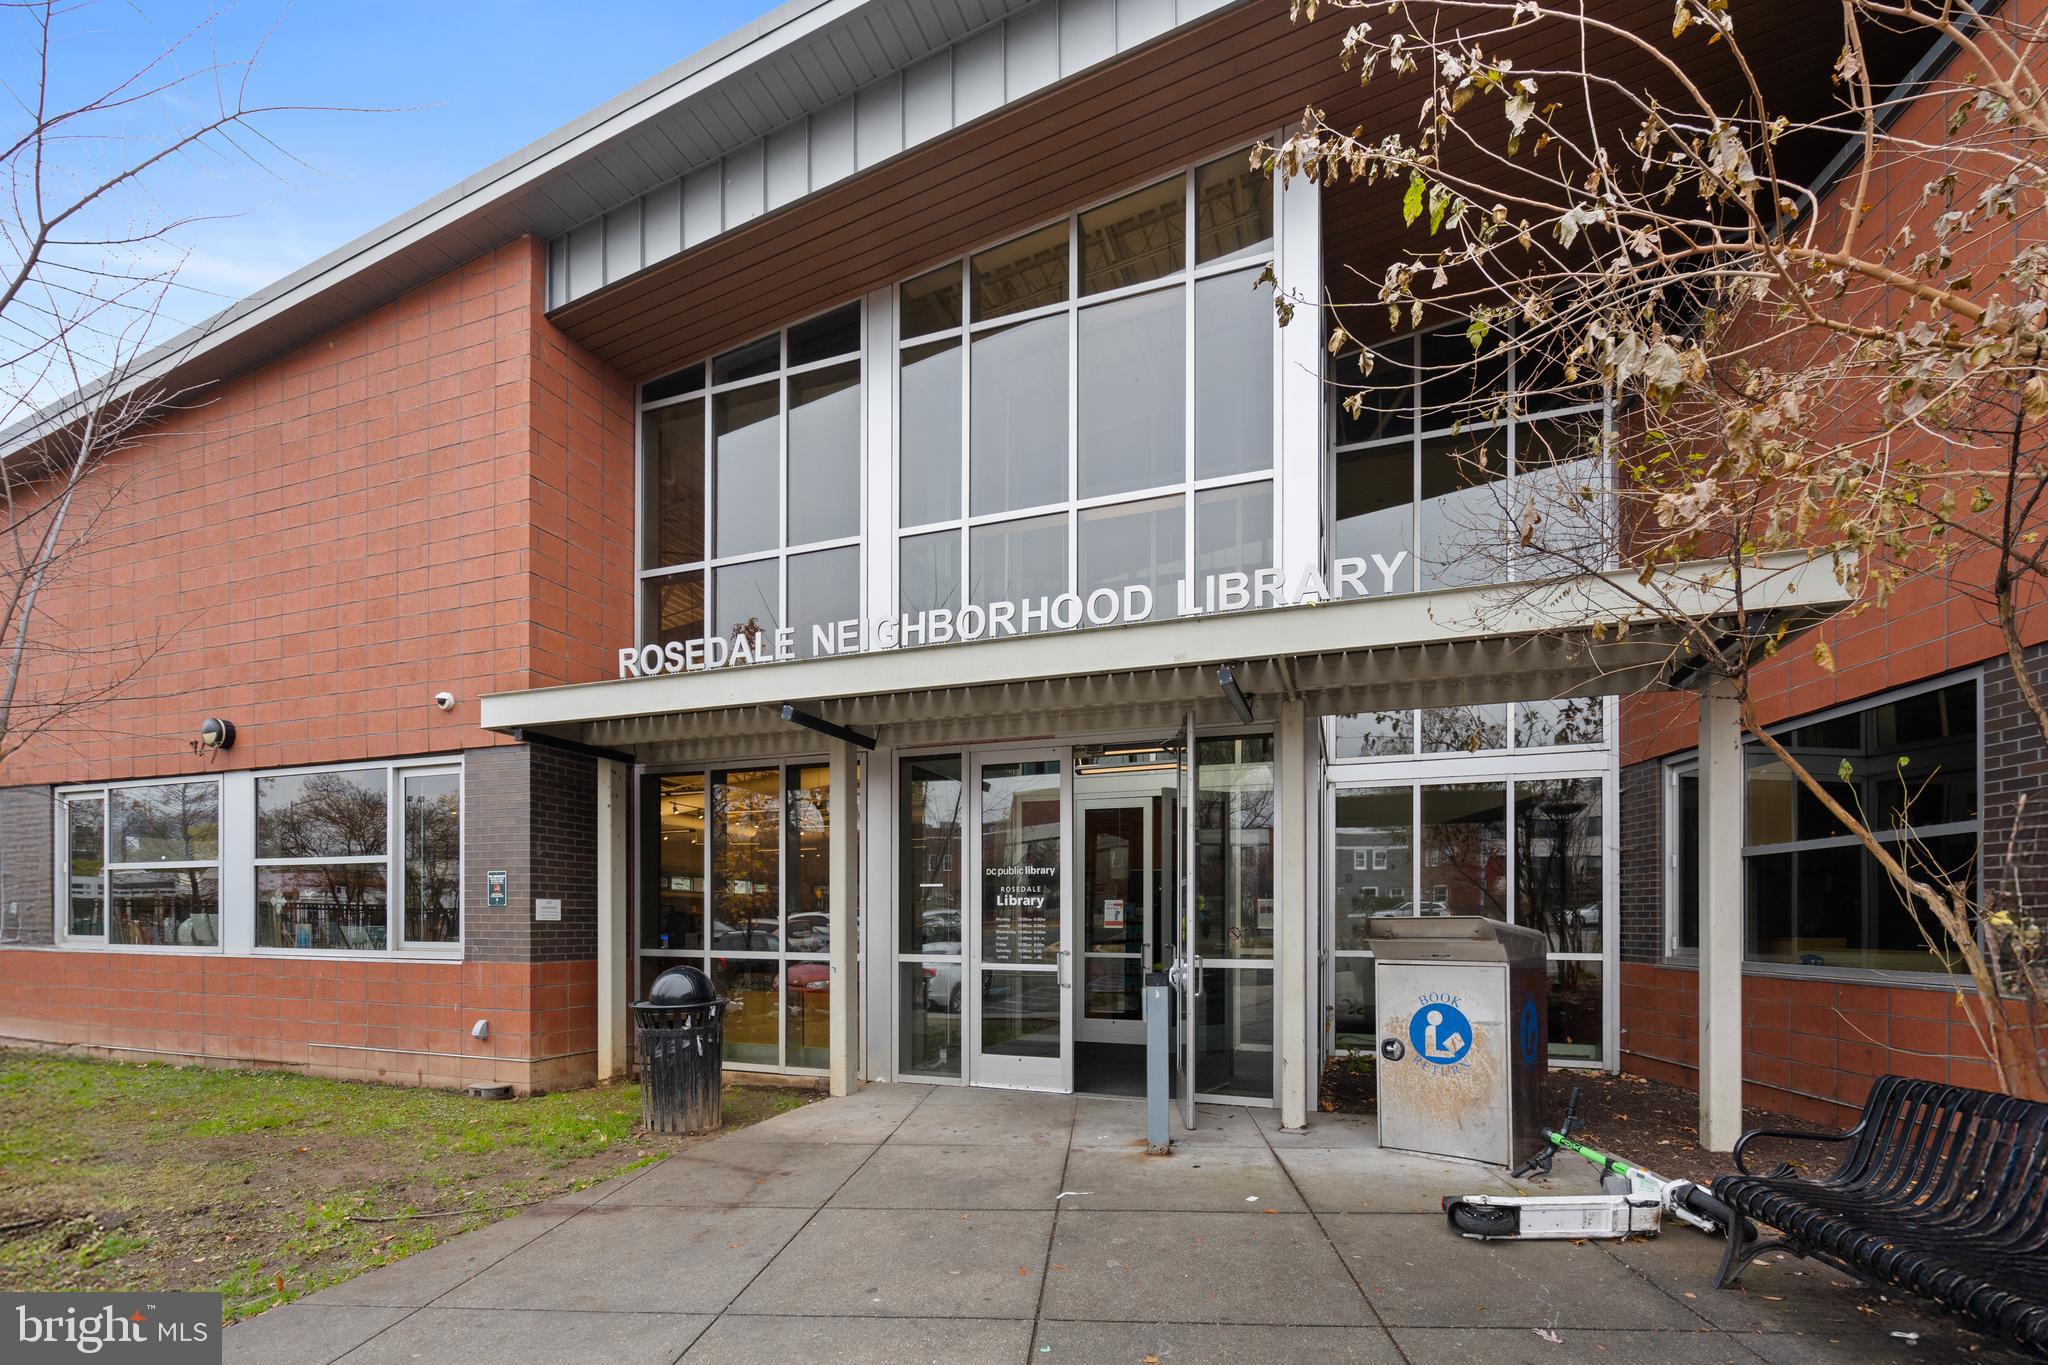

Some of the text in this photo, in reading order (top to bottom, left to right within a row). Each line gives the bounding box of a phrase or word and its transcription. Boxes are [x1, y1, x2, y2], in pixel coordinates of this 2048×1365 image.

[618, 551, 1409, 679] ROSEDALE NEIGHBORHOOD LIBRARY
[986, 865, 1055, 877] DC public library
[996, 894, 1045, 908] Library
[1418, 992, 1462, 1008] BOOK
